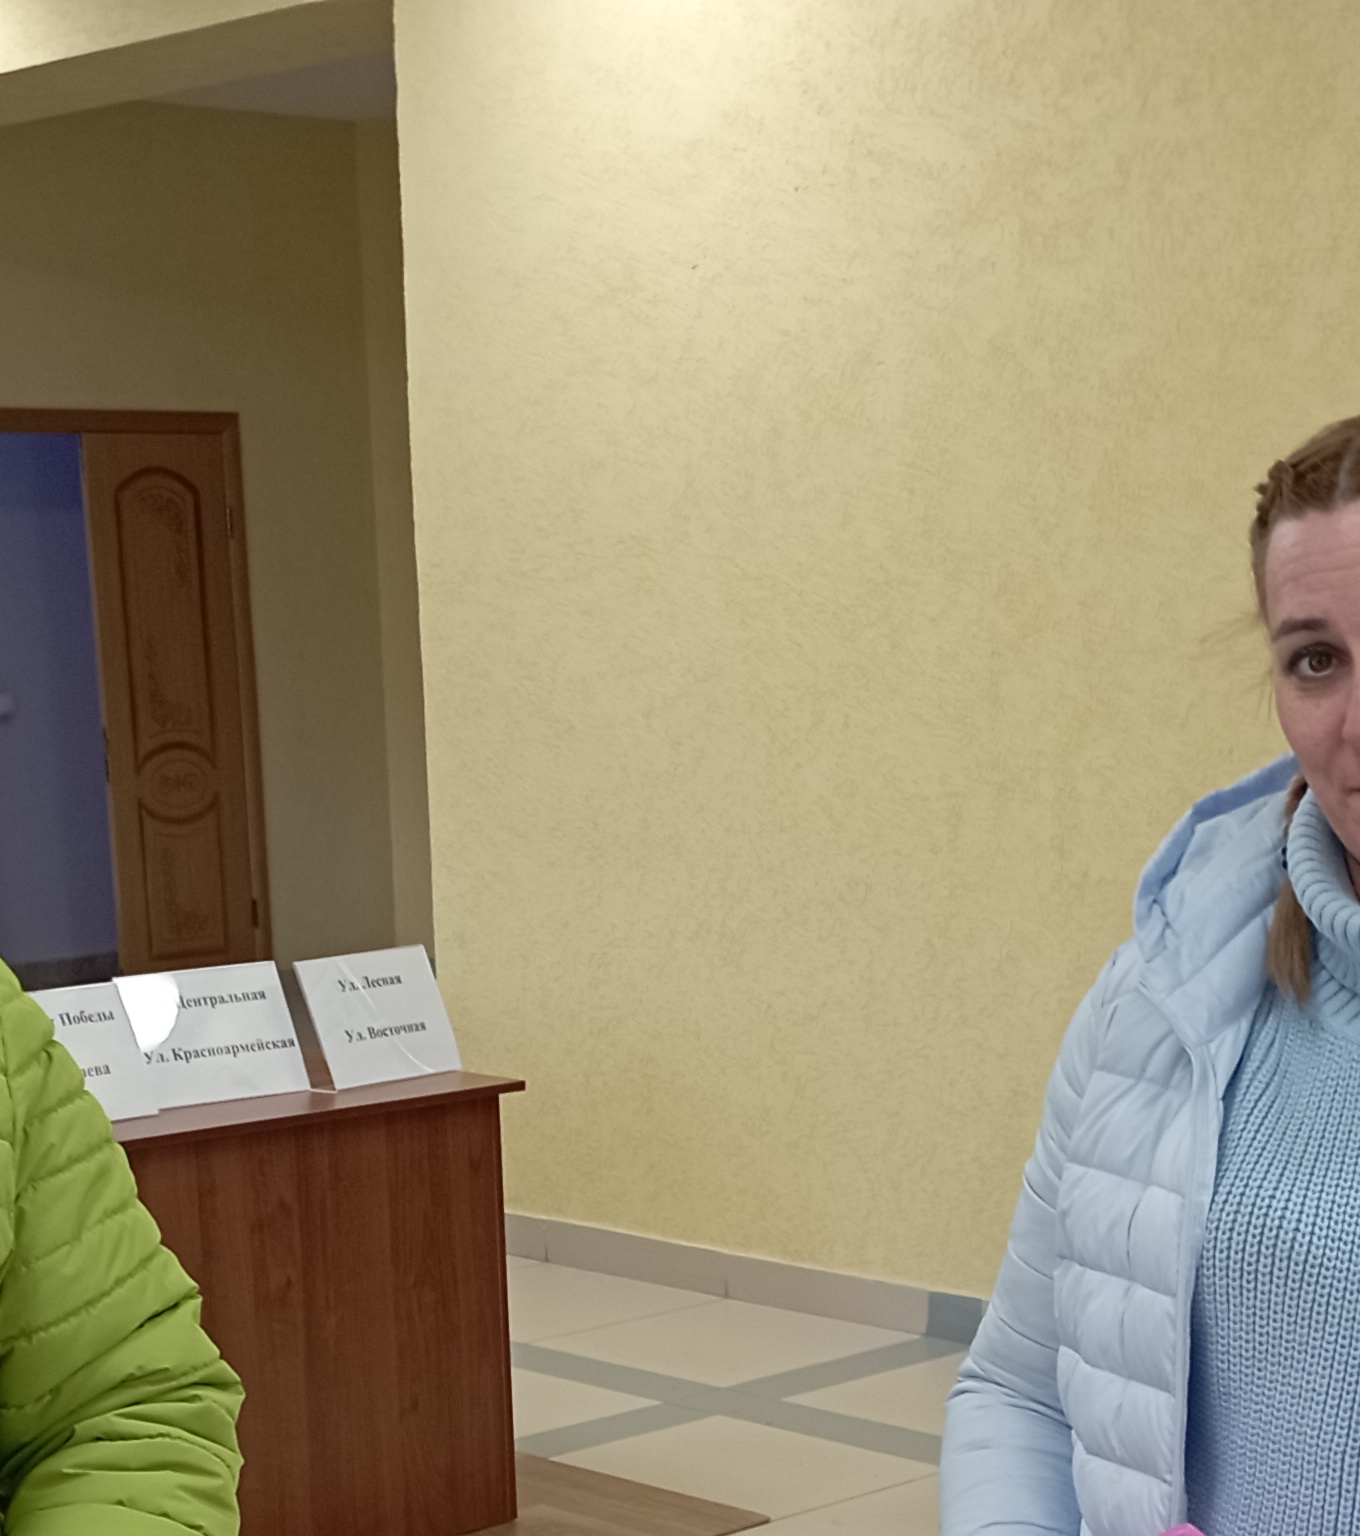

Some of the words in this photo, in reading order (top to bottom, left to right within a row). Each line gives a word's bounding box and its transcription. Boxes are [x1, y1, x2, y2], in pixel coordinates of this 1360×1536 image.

[338, 978, 360, 993] Ул.
[361, 974, 403, 990] Лесная
[344, 1028, 367, 1044] Ул.
[367, 1020, 428, 1040] Восточная
[144, 1050, 170, 1065] Ул.
[172, 1037, 296, 1064] Красноармейская
